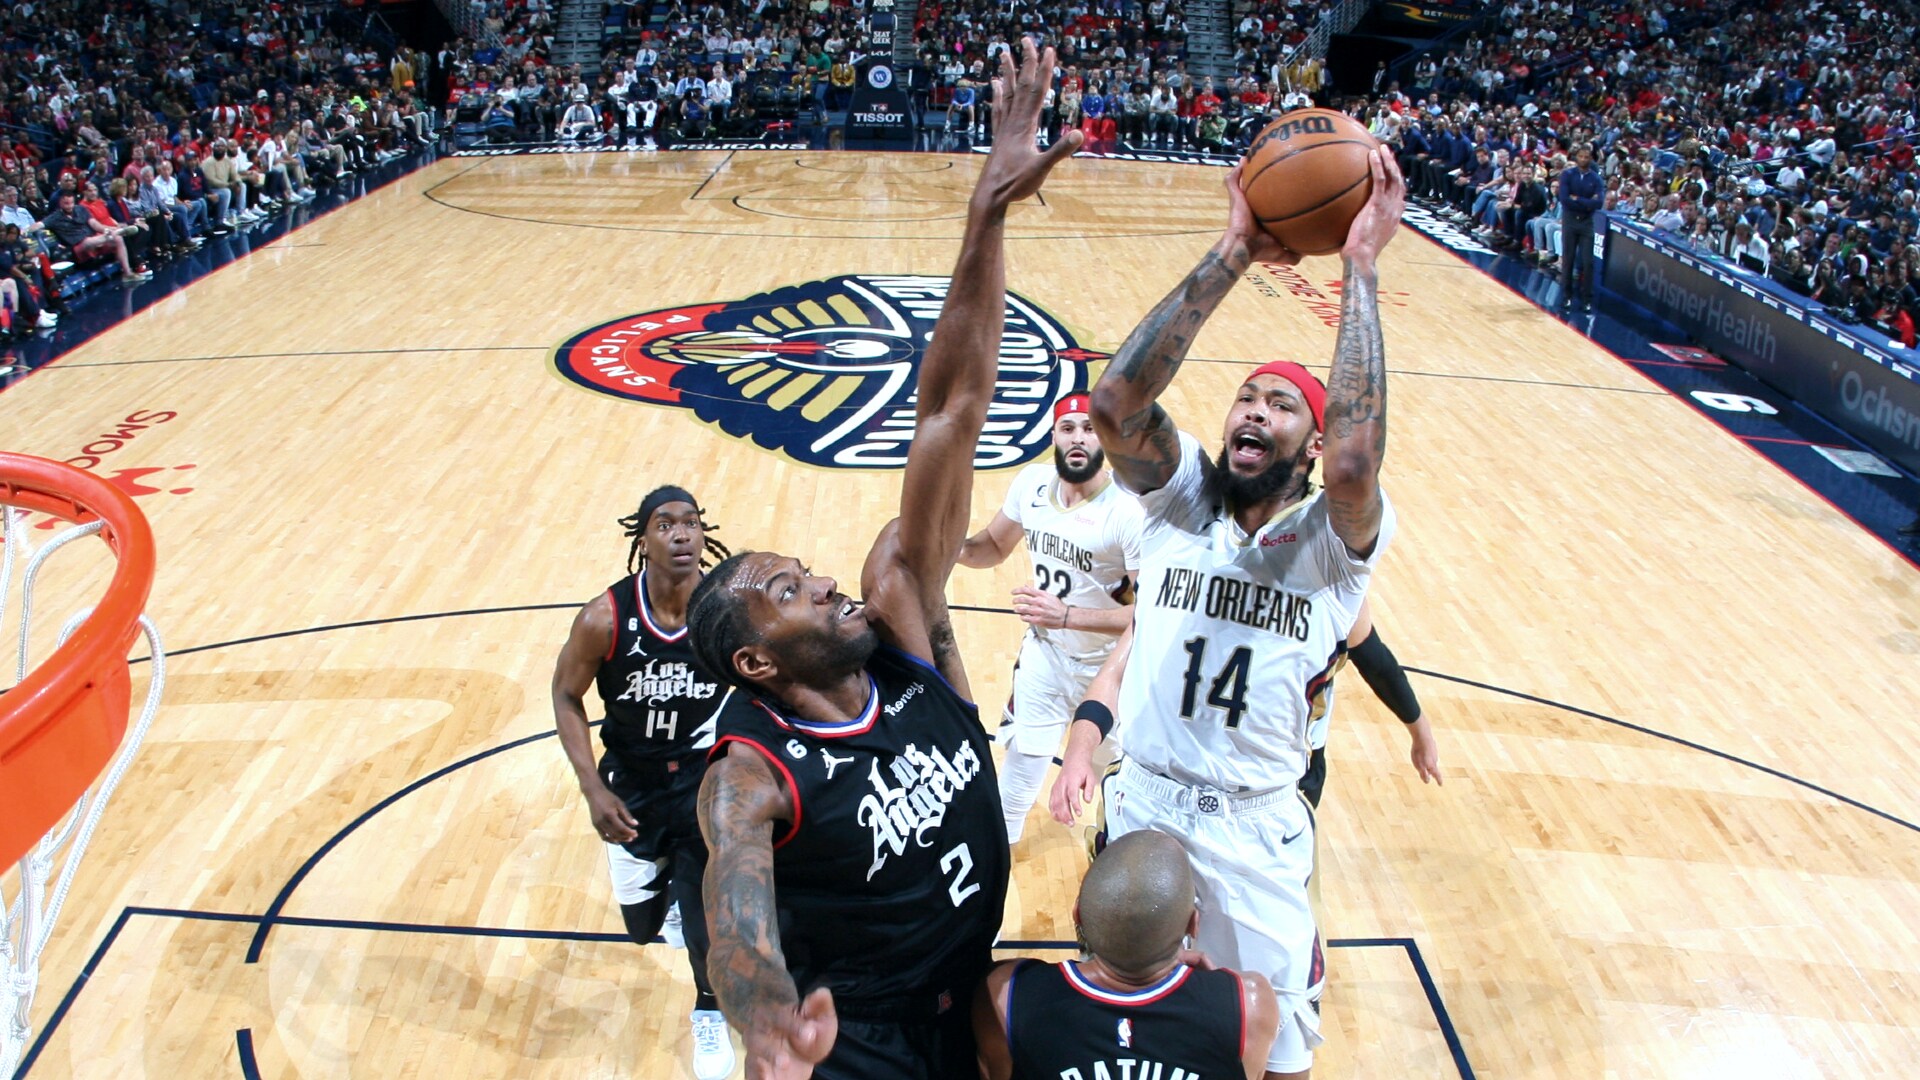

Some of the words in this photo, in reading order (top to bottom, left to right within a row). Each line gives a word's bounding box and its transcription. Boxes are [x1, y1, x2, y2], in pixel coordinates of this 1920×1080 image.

[853, 113, 904, 122] TISSOT
[451, 148, 523, 157] NEW
[591, 314, 692, 386] PELICANS
[1042, 532, 1093, 572] ORLEANS
[1155, 567, 1206, 613] NEW
[1205, 575, 1312, 642] ORLEANS
[628, 618, 638, 631] 6
[644, 658, 689, 681] Los
[1178, 635, 1254, 730] 14
[616, 671, 718, 707] Angeles
[884, 681, 924, 716] honey
[645, 709, 679, 741] 14
[786, 739, 808, 759] 6
[868, 743, 937, 807] Los
[857, 739, 981, 882] Angeles
[939, 842, 981, 908] 2
